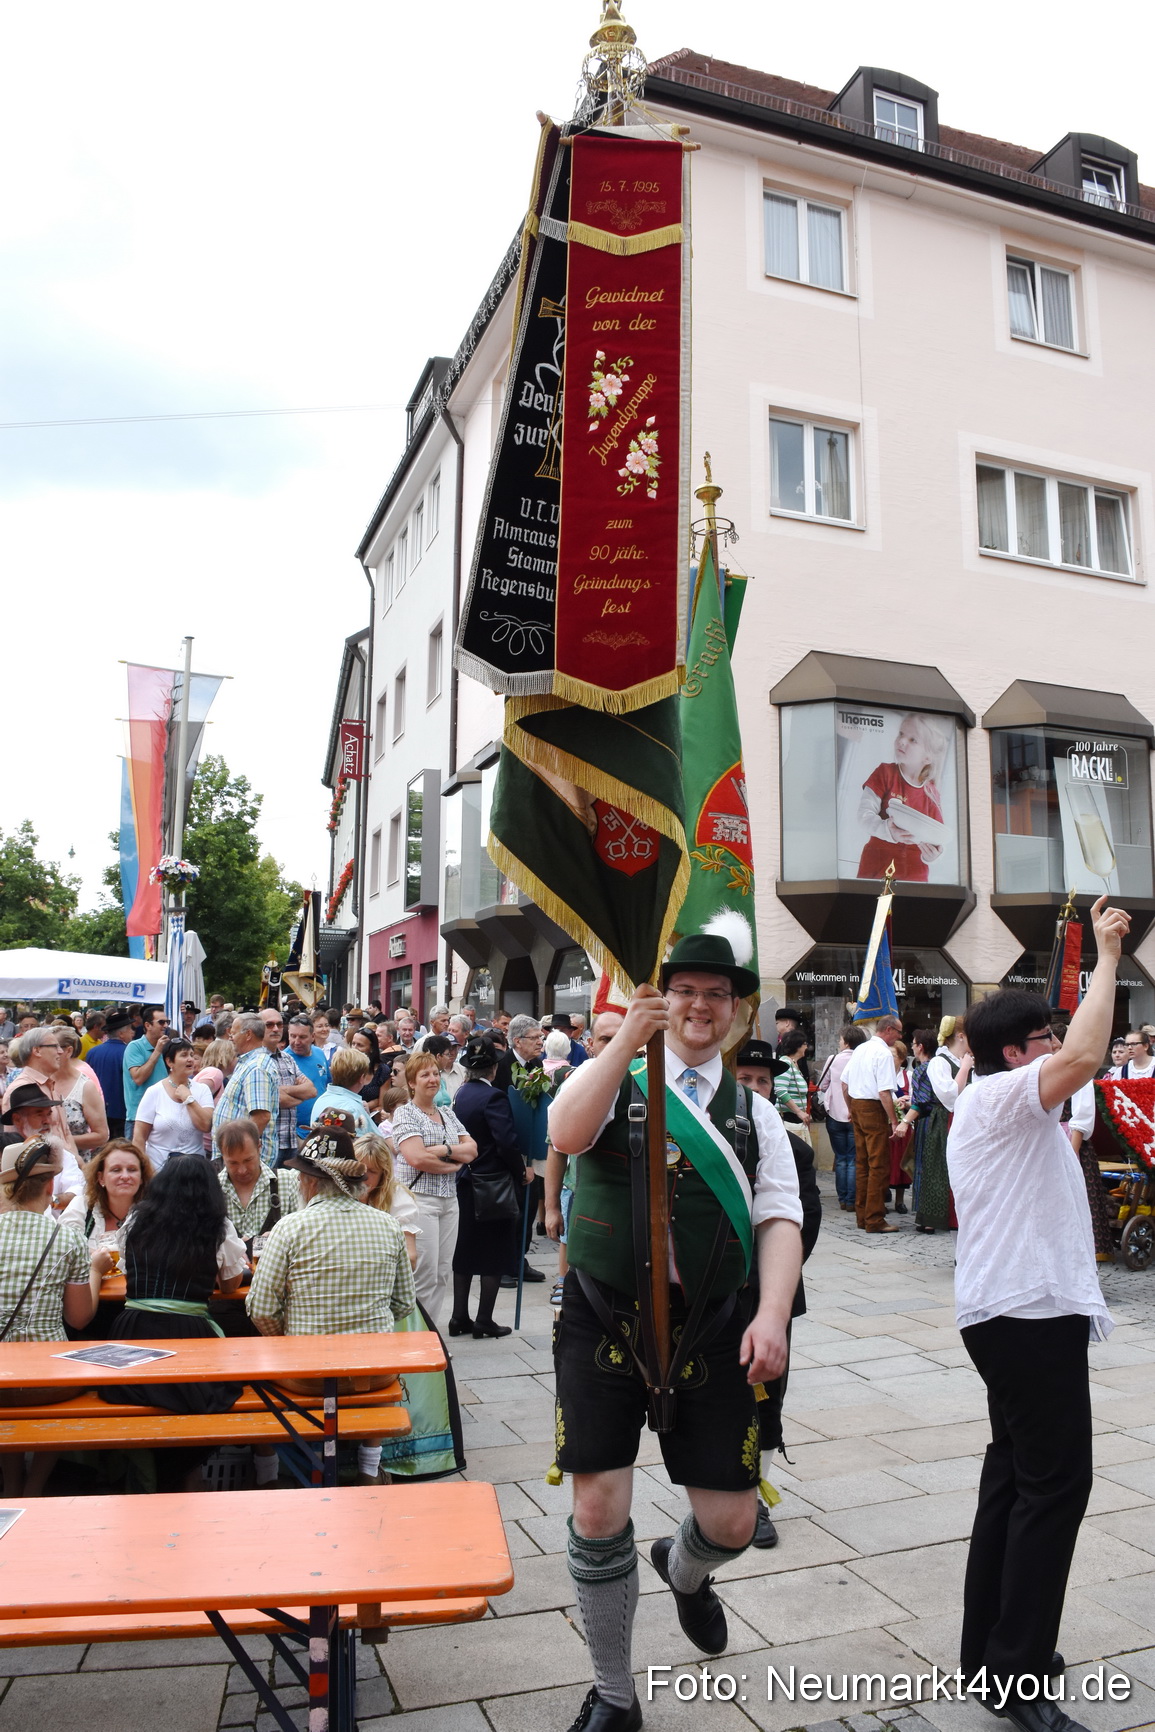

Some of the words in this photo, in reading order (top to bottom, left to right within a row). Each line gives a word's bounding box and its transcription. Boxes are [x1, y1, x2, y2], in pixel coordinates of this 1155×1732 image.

[599, 180, 615, 192] 15.
[618, 180, 629, 192] 7.
[632, 180, 661, 193] 1995
[585, 286, 665, 308] Gewidmet
[592, 319, 621, 332] von
[628, 314, 656, 331] der
[518, 380, 554, 414] Den
[588, 372, 658, 466] Jugendgruppe
[493, 516, 559, 549] Almraus
[605, 518, 633, 530] zum
[506, 546, 558, 576] Stamm
[589, 545, 610, 560] 90
[610, 544, 648, 564] jähr.
[480, 568, 556, 602] Regensbu
[601, 598, 632, 618] fest
[838, 710, 884, 728] Thomas
[344, 732, 358, 774] Achatz
[1074, 742, 1090, 752] 100
[1092, 741, 1118, 754] Jahre
[1071, 754, 1114, 782] RACKL
[796, 972, 846, 982] Willkommen
[850, 973, 860, 982] im
[1008, 976, 1047, 984] Willkomme
